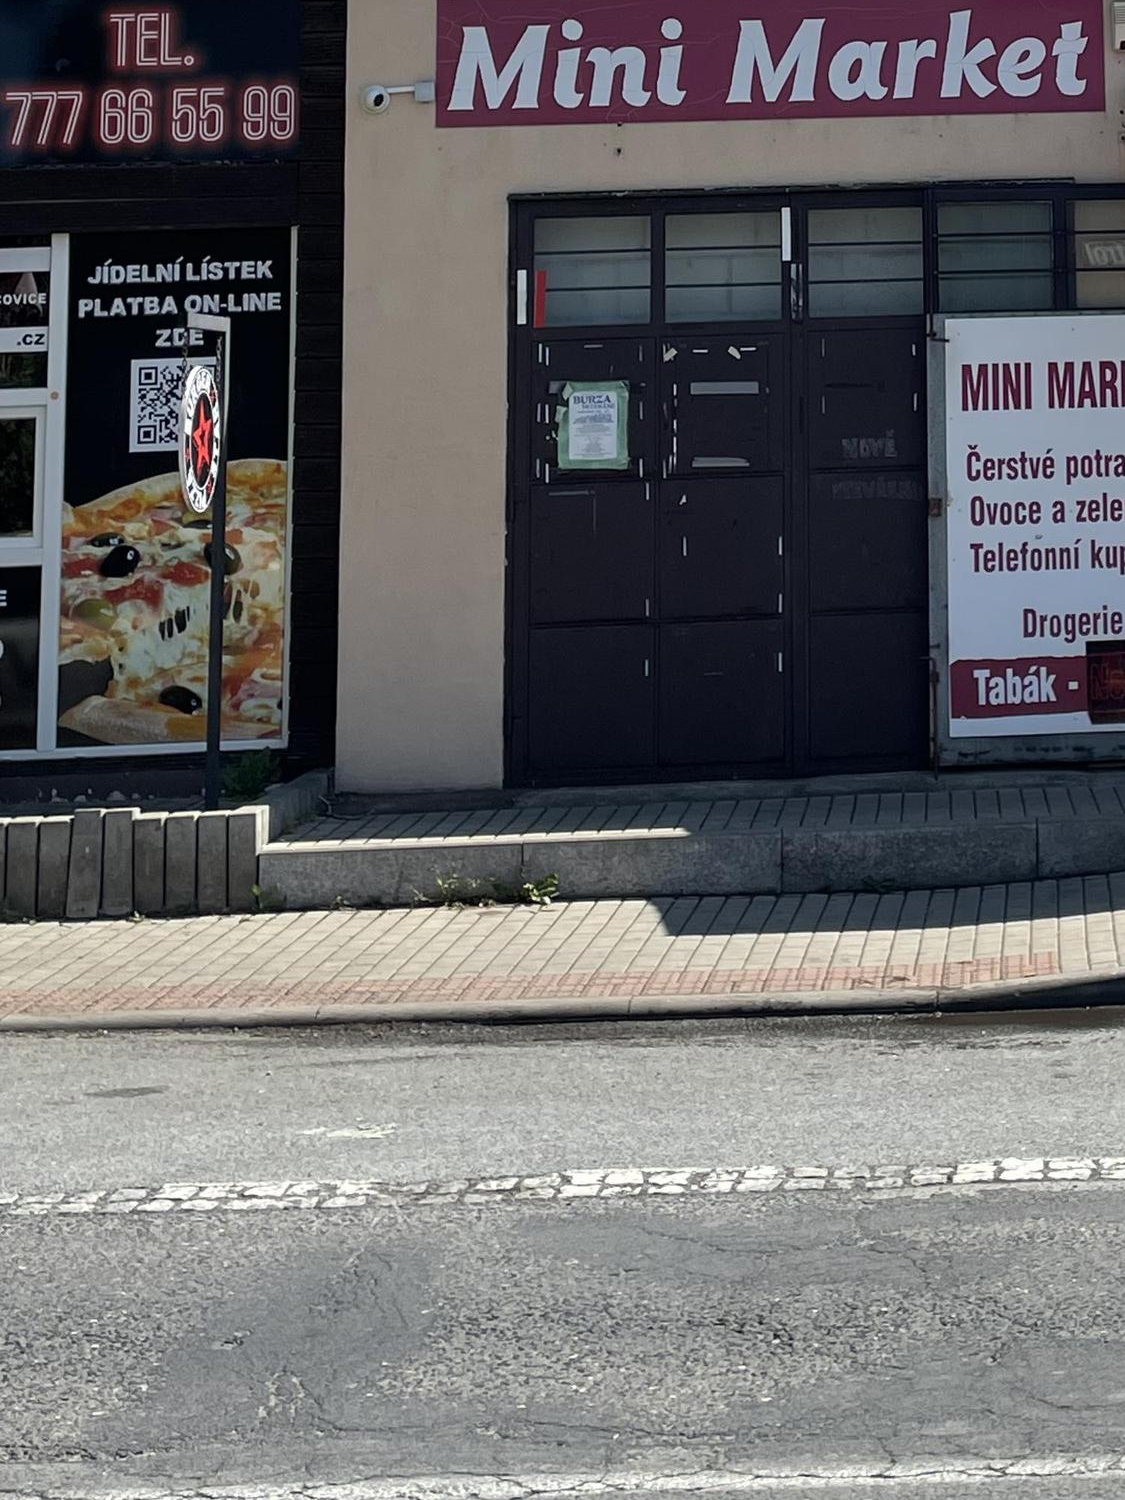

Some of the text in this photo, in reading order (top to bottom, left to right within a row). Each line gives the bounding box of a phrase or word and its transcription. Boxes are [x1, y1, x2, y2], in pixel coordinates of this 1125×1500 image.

[110, 12, 195, 67] TEL.
[447, 9, 1088, 111] Mini Market
[6, 85, 295, 146] 777 66 55 99
[87, 255, 274, 285] JÍDELNÍ LÍSTEK
[78, 292, 282, 319] PLATBA ON-LINE
[961, 362, 1032, 412] MINI
[966, 444, 1055, 482] Čerstvé
[970, 495, 1042, 526] Ovoce
[1052, 501, 1065, 523] a
[969, 538, 1082, 573] Telefonní
[1023, 605, 1124, 643] Drogerie
[973, 666, 1057, 706] Tabák
[1067, 680, 1079, 691] -
